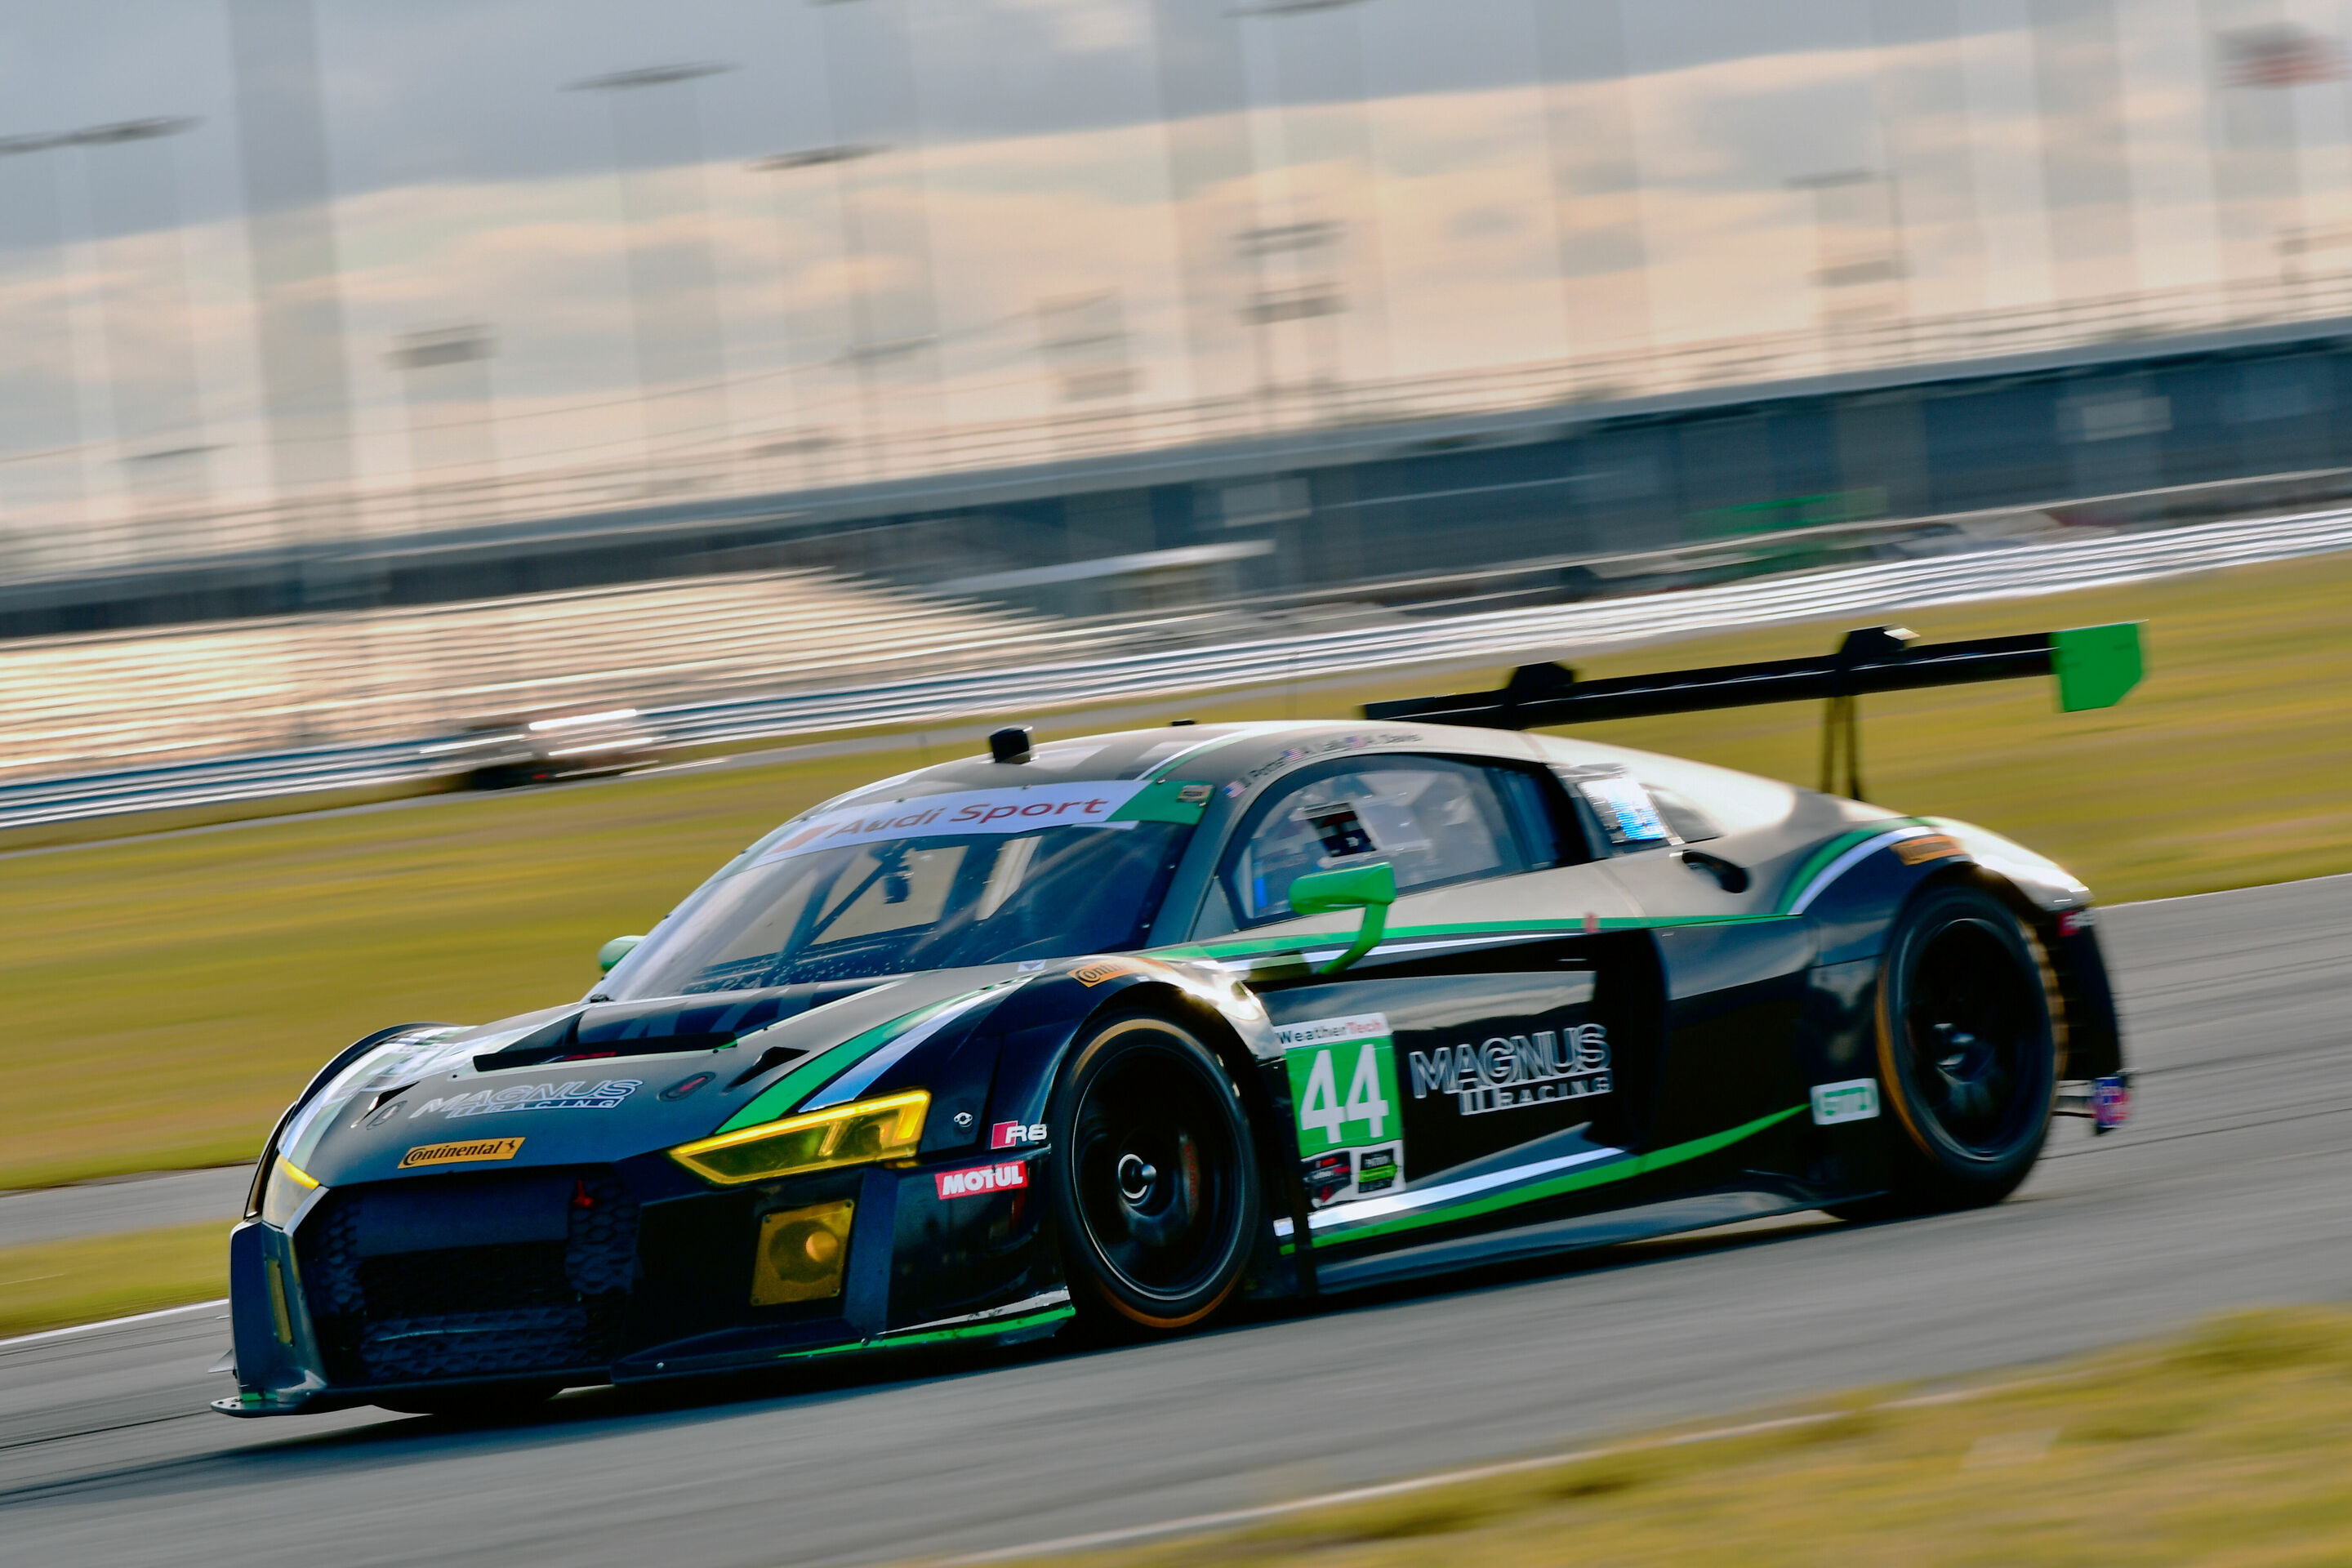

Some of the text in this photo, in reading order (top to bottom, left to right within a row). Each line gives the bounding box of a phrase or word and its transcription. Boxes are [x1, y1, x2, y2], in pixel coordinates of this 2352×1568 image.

[827, 797, 1110, 840] Audi Sport
[1276, 1021, 1385, 1045] WeatherTech
[1408, 1022, 1612, 1099] MAGNUS
[409, 1079, 644, 1119] MAGNUS
[489, 1096, 621, 1114] RACING
[1300, 1044, 1390, 1144] 44
[1496, 1076, 1613, 1107] RACING
[1004, 1123, 1048, 1144] R8
[402, 1141, 503, 1167] Continental
[942, 1165, 1024, 1196] MOTUL
